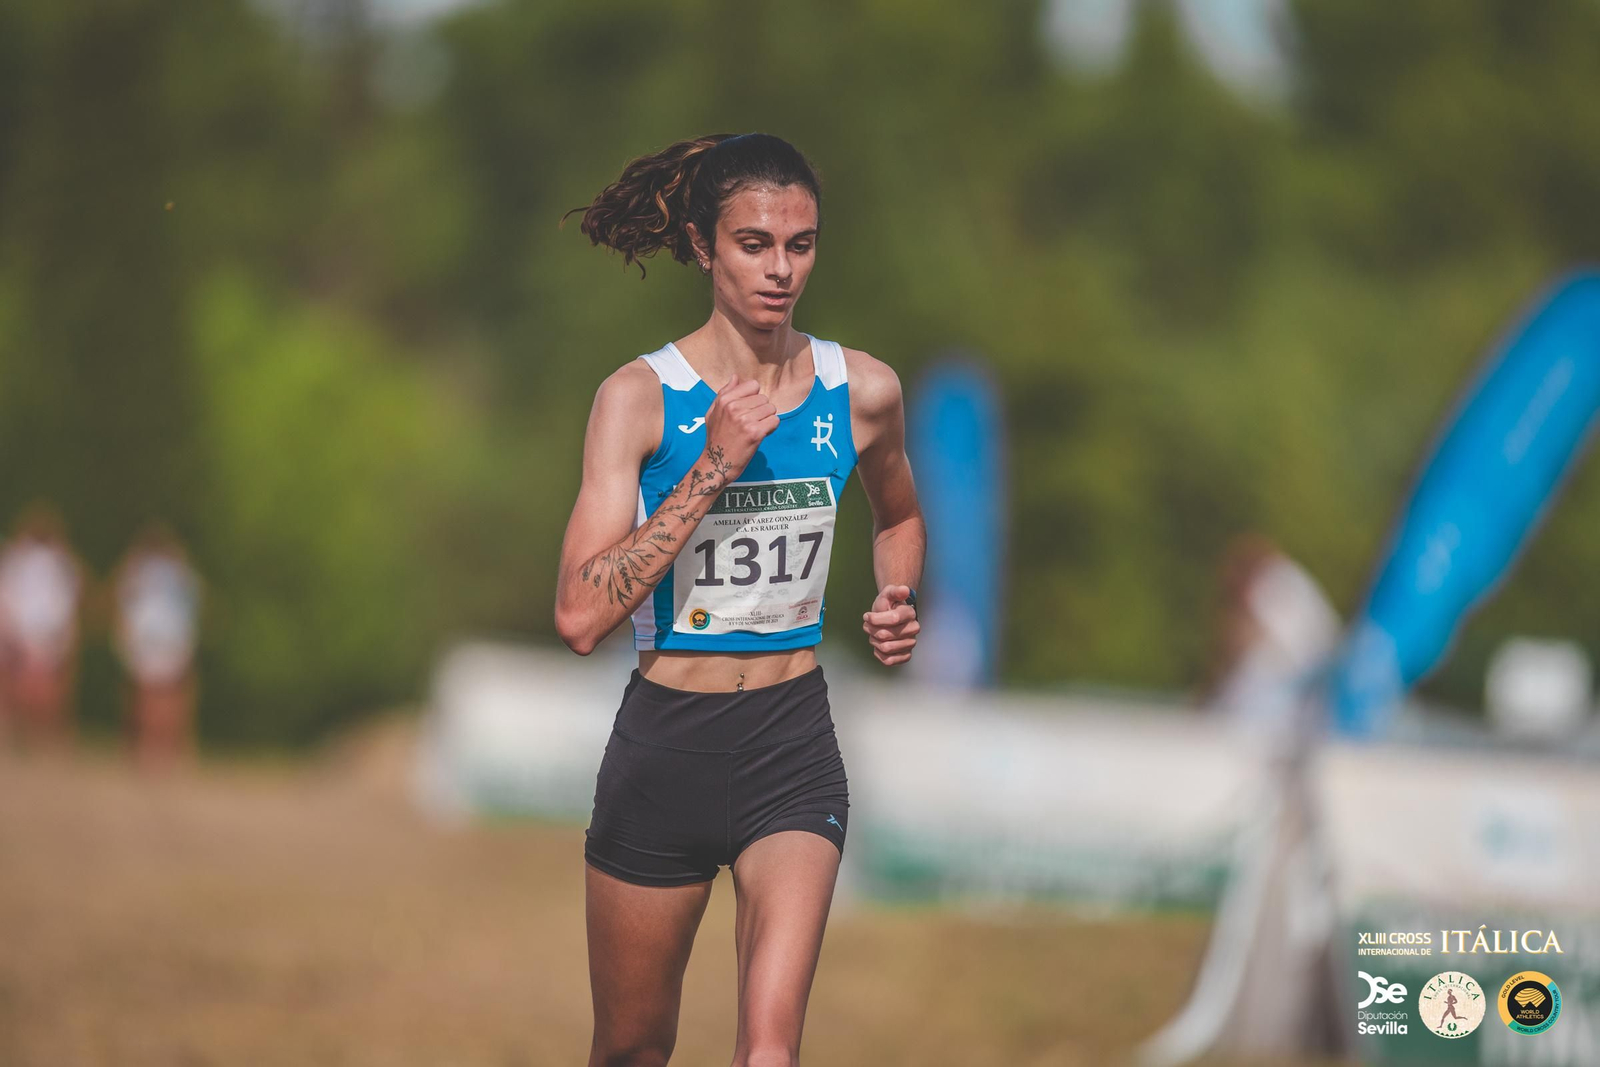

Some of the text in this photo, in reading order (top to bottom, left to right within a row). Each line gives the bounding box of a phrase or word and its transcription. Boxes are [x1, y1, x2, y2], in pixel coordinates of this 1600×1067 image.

[725, 488, 797, 508] ITÁLICA
[742, 516, 774, 525] ÁLVAREZ
[774, 514, 809, 522] GONZÁLEZ
[760, 523, 789, 532] RAIGUER
[694, 531, 824, 587] 1317
